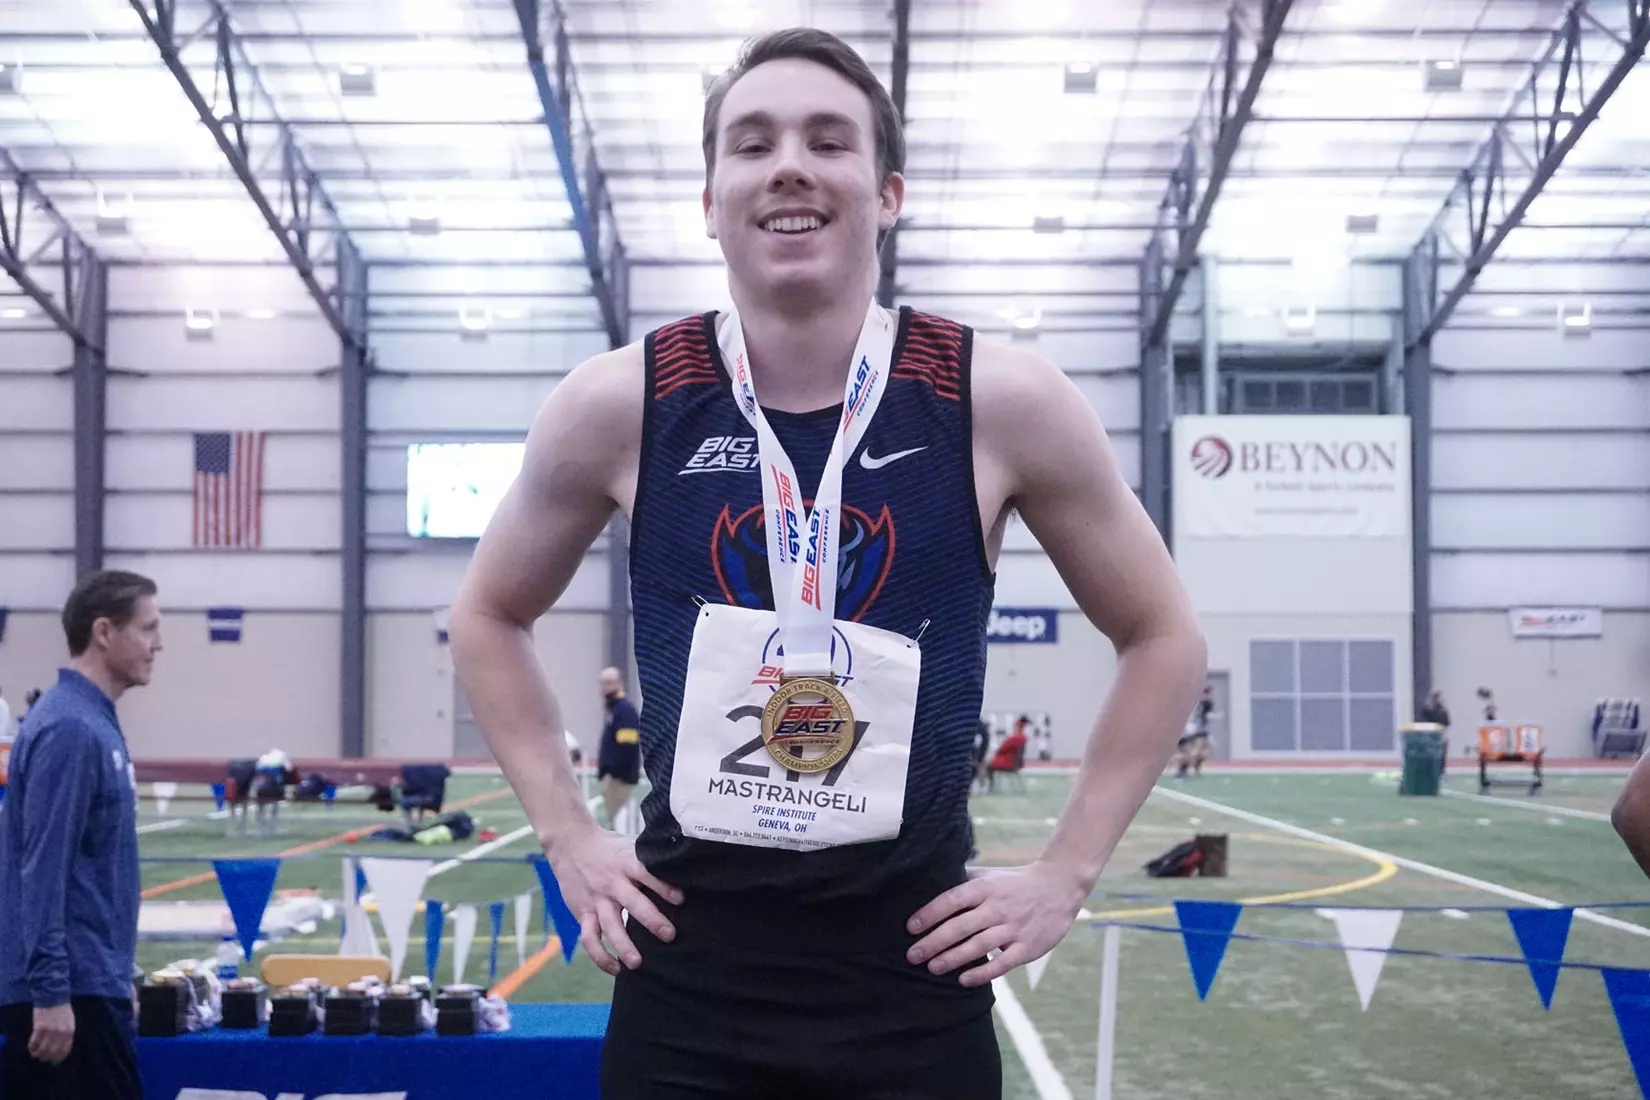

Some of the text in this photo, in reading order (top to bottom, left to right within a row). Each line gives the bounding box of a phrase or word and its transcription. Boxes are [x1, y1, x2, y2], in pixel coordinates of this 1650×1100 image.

[847, 354, 871, 413] EAST
[857, 370, 879, 417] CONFERENCE
[685, 452, 760, 468] EAST
[696, 436, 756, 453] BIG
[1240, 441, 1397, 472] BEYNON
[779, 471, 796, 512] BIG
[775, 508, 785, 563] CONFERENCE
[821, 508, 830, 563] CONFERENCE
[801, 507, 820, 605] BIG EAST
[767, 688, 792, 717] INDOOR
[794, 683, 821, 691] TRACK
[784, 704, 834, 720] BIG
[775, 719, 847, 734] EAST
[719, 705, 870, 787] 27
[774, 748, 844, 770] CHAMPIONSHIPS
[708, 777, 867, 813] MASTRANGELI
[752, 804, 817, 821] SPIRE INSTITUTE
[758, 818, 807, 833] GENEVA, OH
